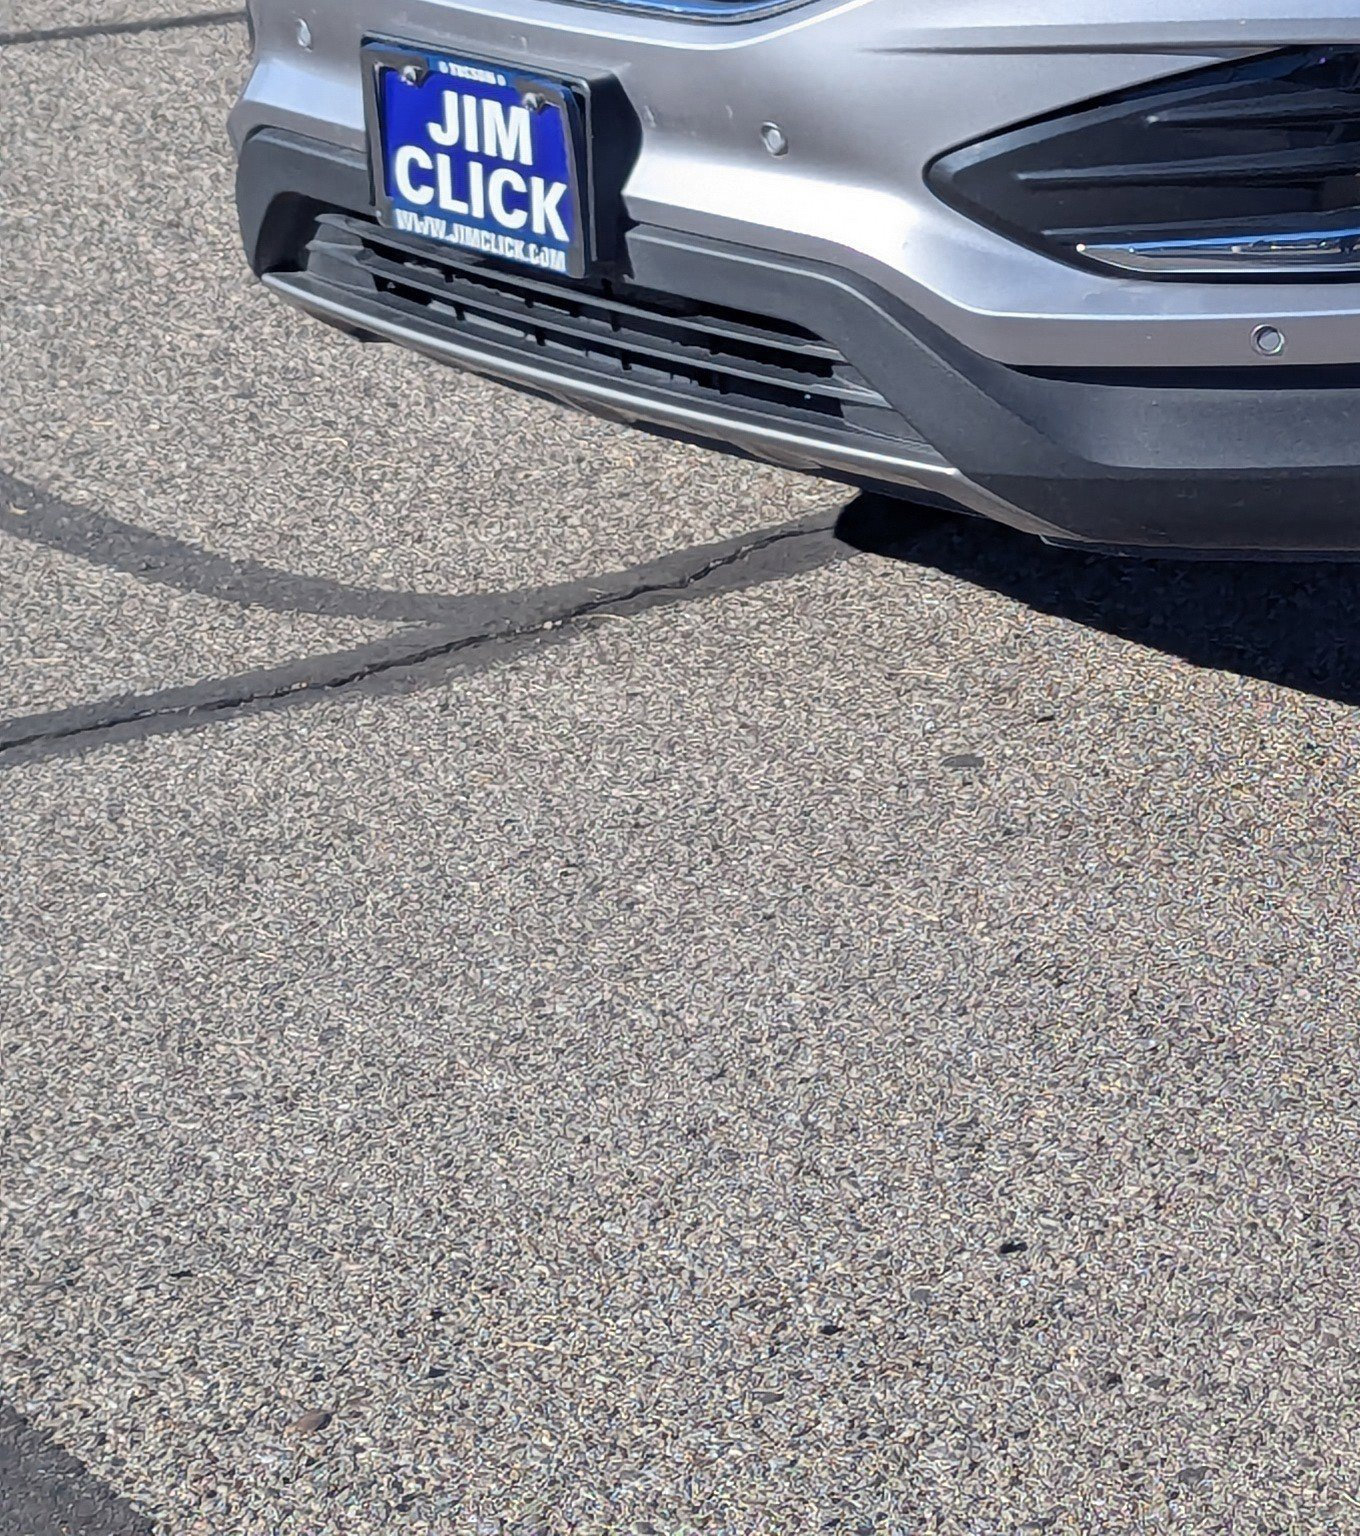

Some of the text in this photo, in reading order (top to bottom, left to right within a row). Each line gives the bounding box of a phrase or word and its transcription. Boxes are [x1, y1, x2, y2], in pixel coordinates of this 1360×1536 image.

[426, 90, 533, 166] JIM
[395, 145, 570, 242] CLICK
[395, 208, 567, 272] WWW.JIMCLICK.COM
